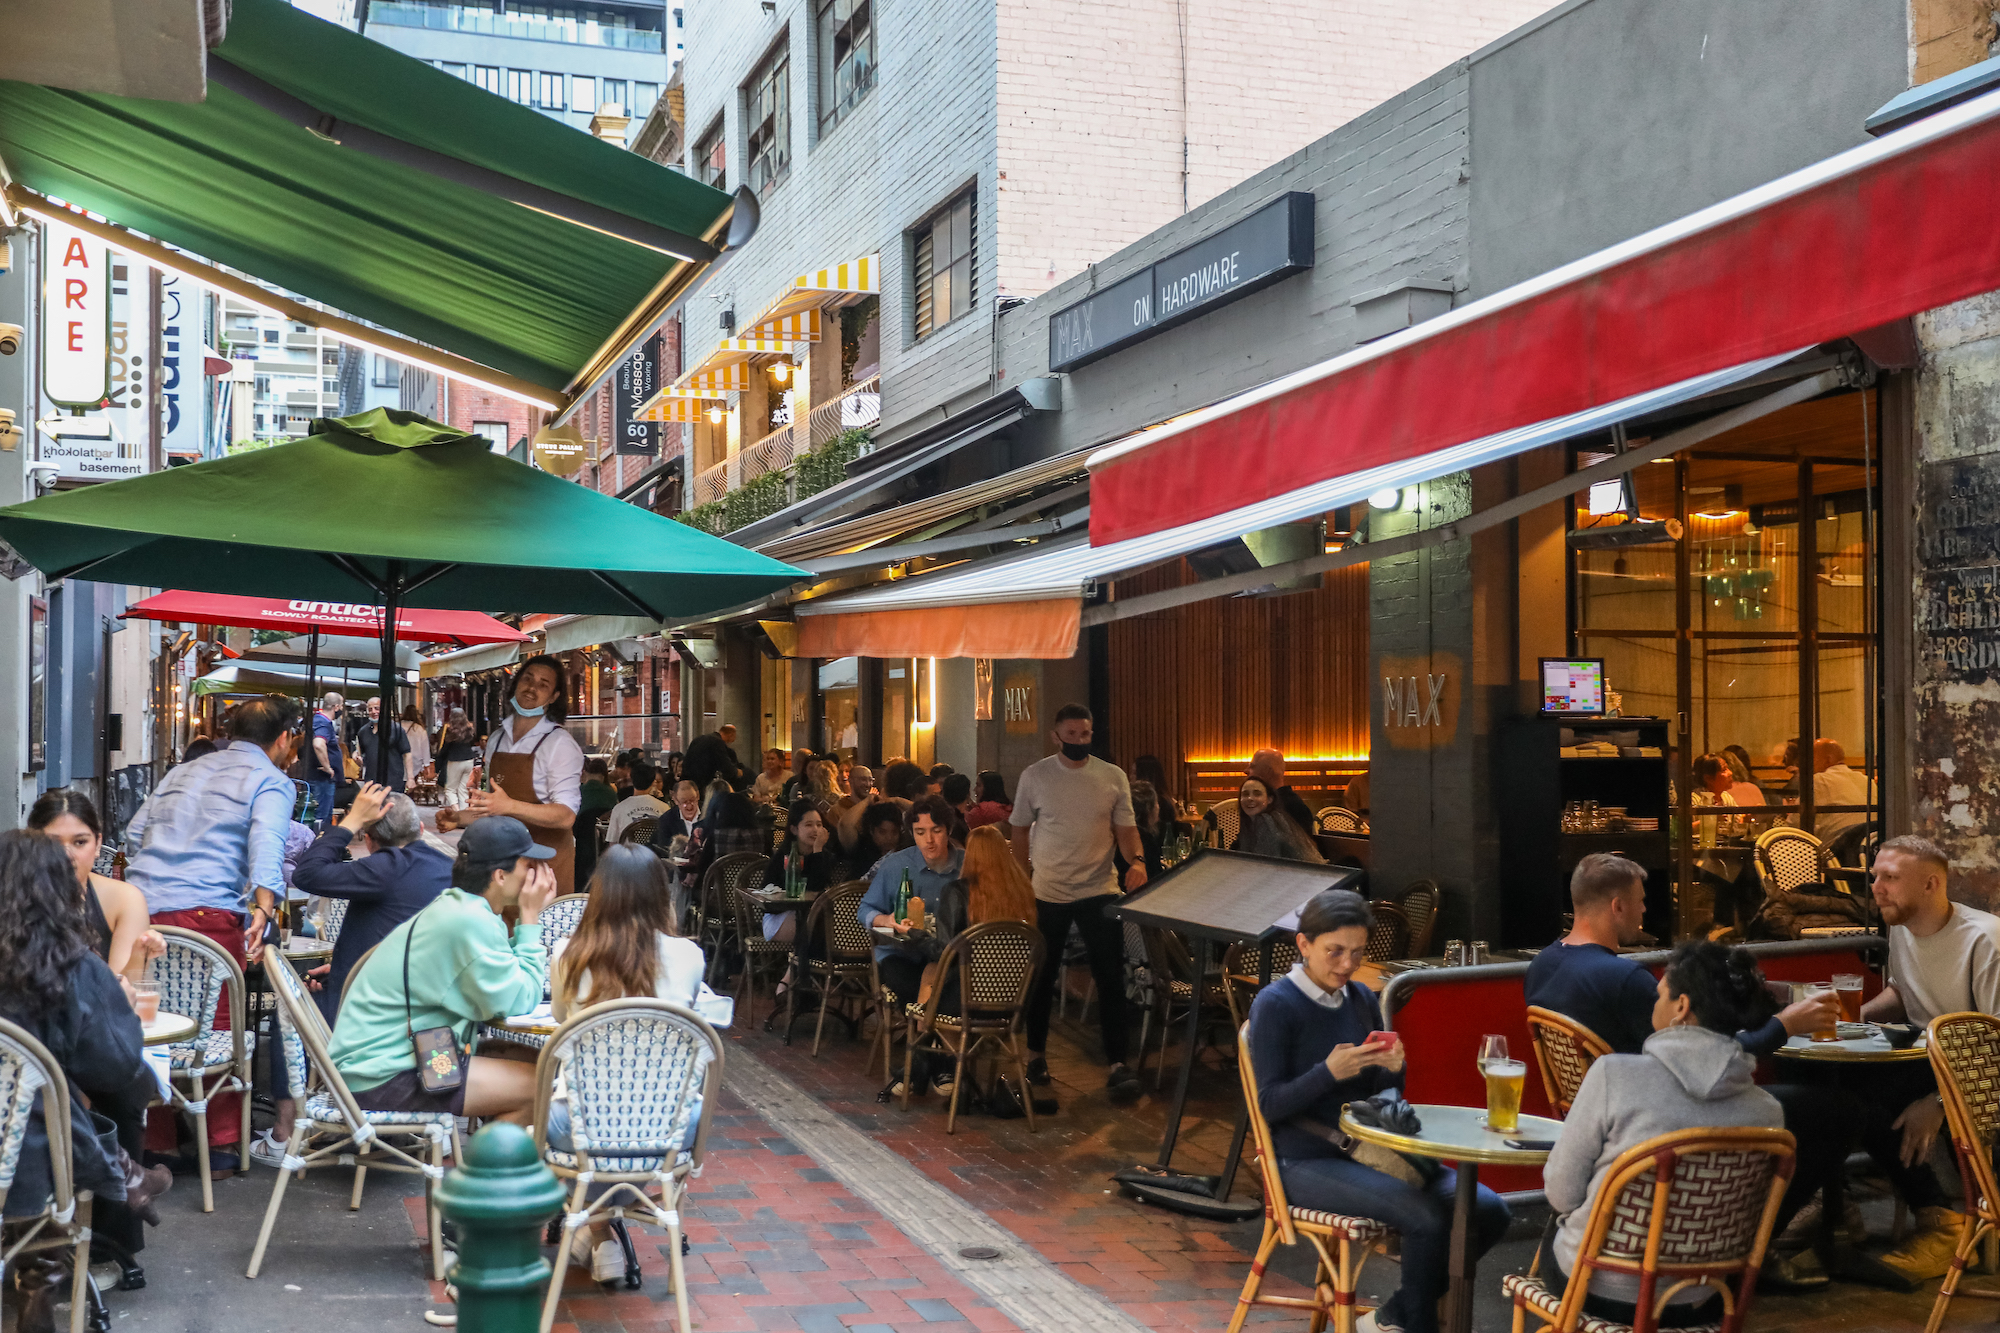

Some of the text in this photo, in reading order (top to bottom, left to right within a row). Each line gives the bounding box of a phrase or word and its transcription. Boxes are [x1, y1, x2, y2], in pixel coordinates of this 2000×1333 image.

[1057, 251, 1240, 361] MAX ON HARDWARE
[645, 361, 653, 391] Waxing
[627, 424, 648, 437] 60
[80, 461, 142, 473] basement
[261, 609, 309, 619] SLOWLY
[311, 614, 366, 624] ROASTED
[1004, 687, 1031, 721] MAX
[1384, 673, 1445, 727] MAX
